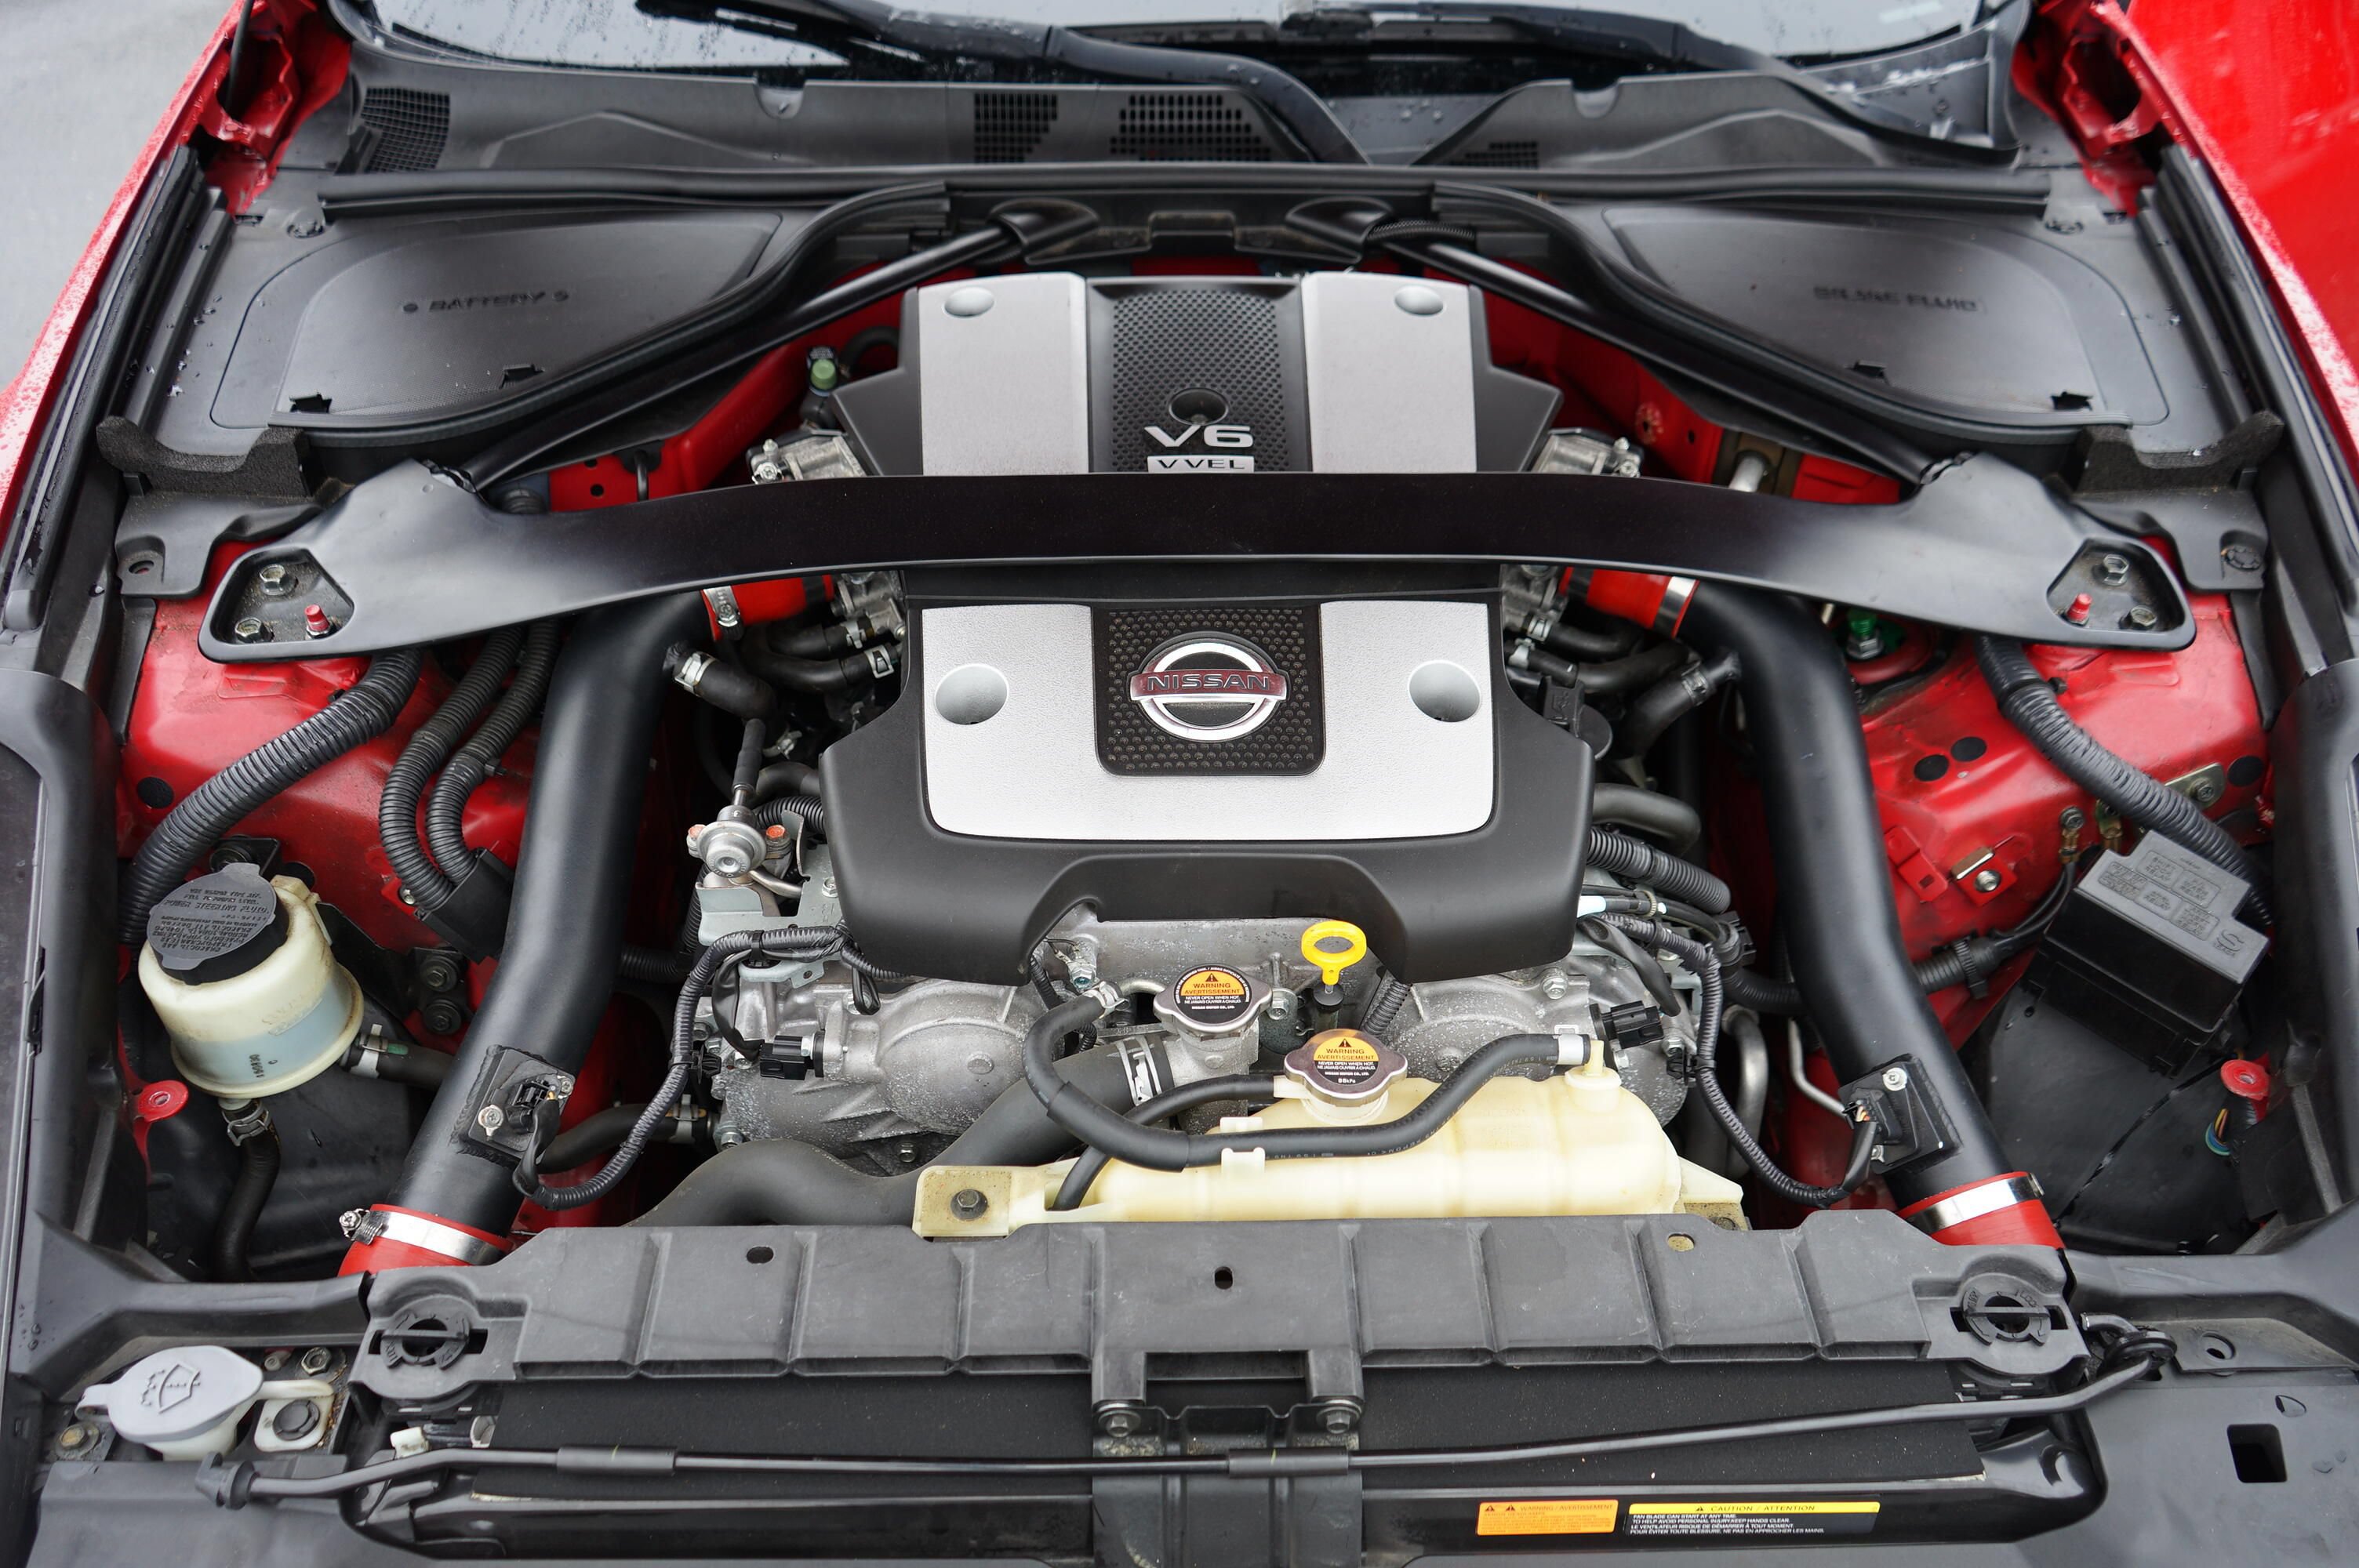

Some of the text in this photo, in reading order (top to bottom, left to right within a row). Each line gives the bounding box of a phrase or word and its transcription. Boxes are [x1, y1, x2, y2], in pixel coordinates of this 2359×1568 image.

[429, 291, 547, 312] BATTERY
[1906, 292, 1978, 312] FLUID
[1144, 423, 1254, 448] V6
[1158, 459, 1245, 469] VVEL
[1147, 674, 1270, 691] NISSAN
[194, 902, 237, 911] STEERING
